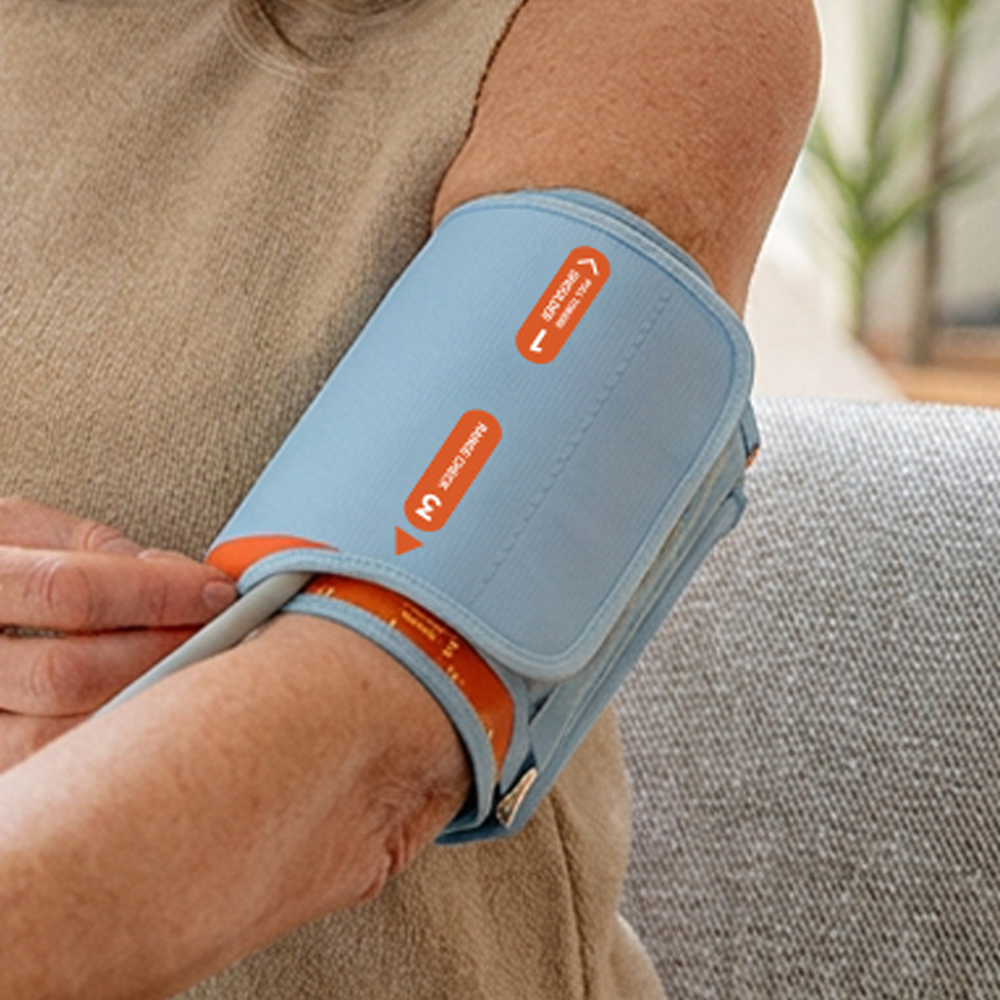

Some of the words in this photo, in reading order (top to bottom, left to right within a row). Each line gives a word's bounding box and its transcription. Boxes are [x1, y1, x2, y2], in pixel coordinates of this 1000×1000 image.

[530, 329, 548, 354] 1
[460, 421, 489, 459] RANGE
[438, 455, 467, 491] CHECK
[415, 494, 443, 523] 3
